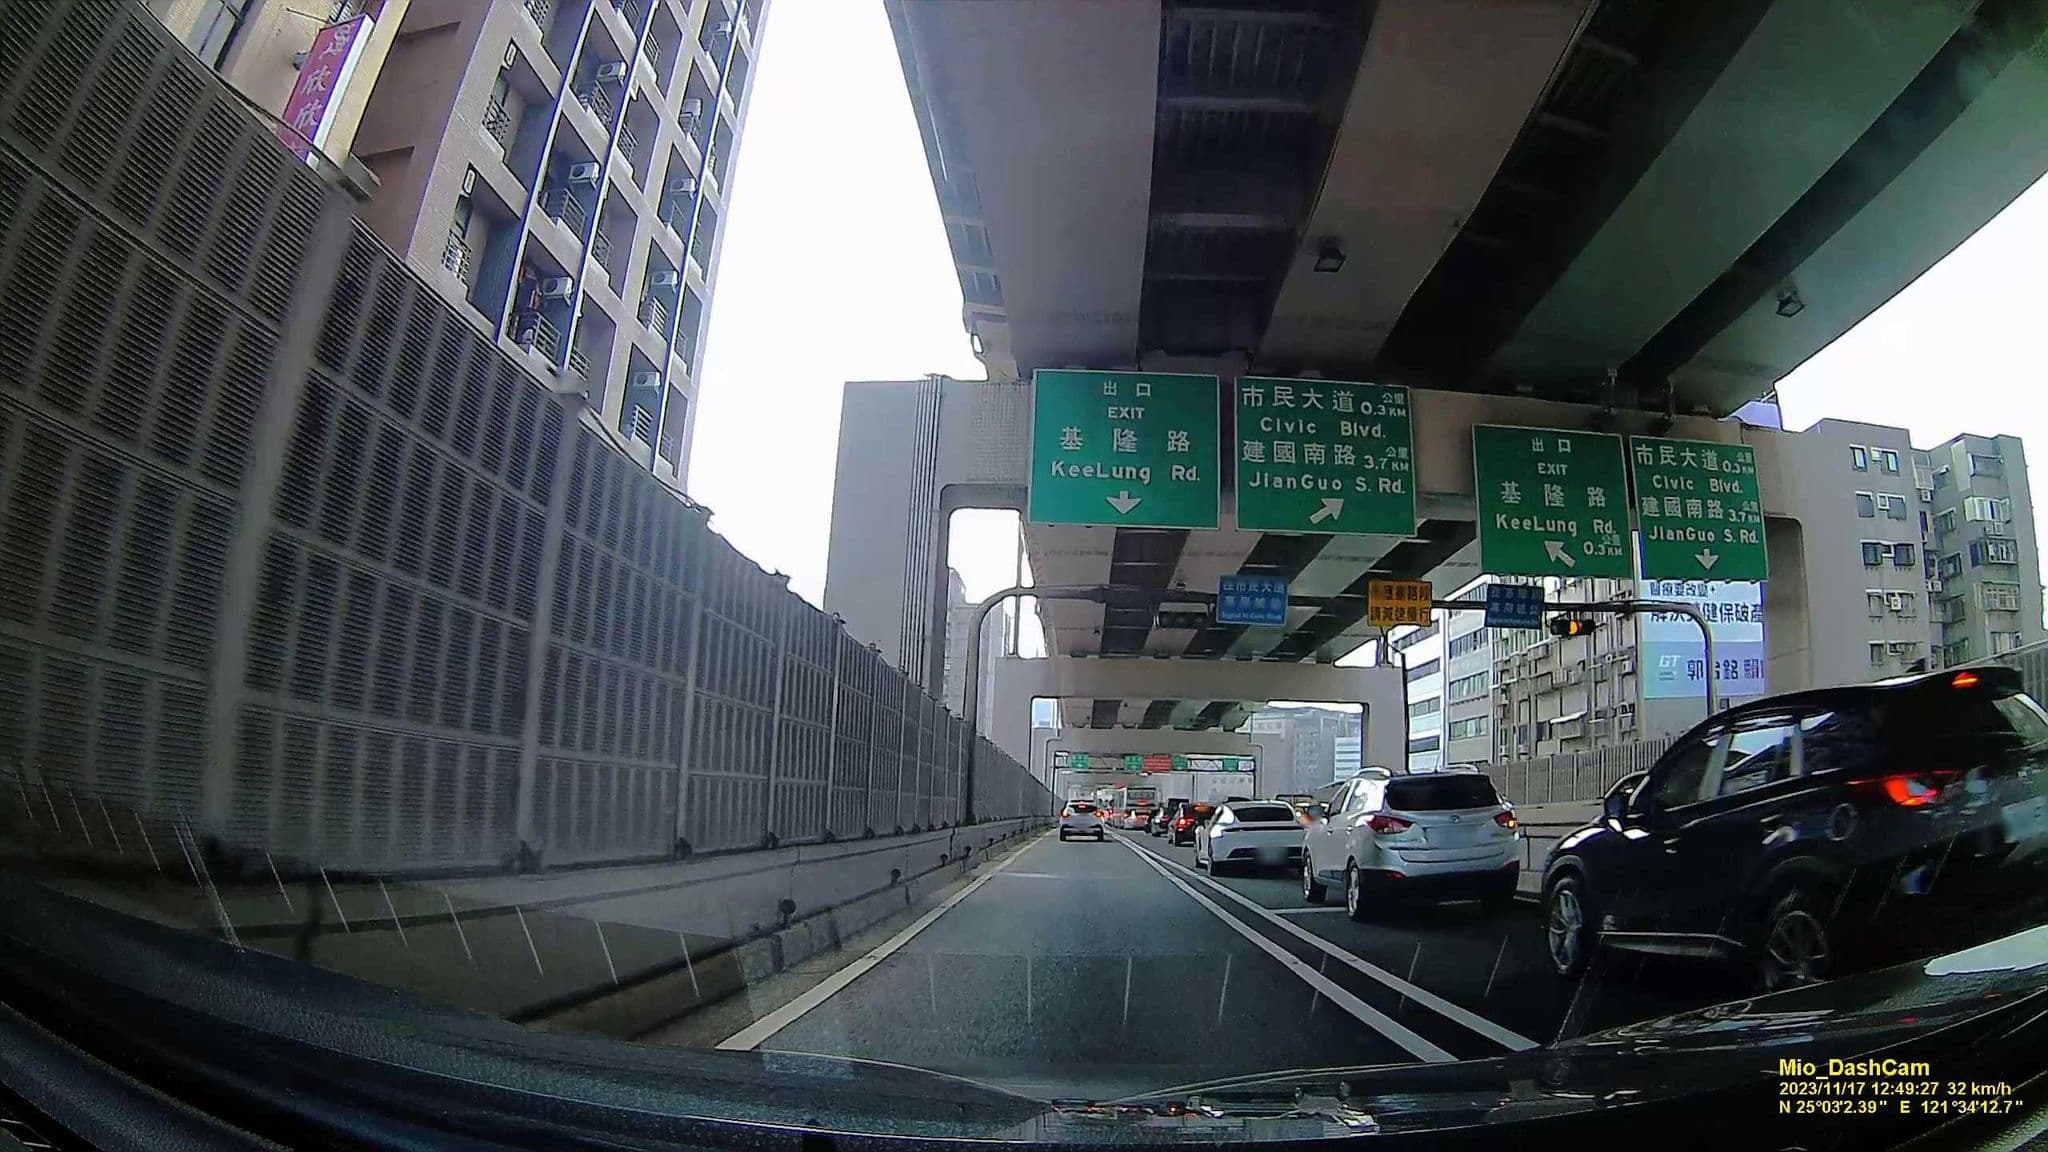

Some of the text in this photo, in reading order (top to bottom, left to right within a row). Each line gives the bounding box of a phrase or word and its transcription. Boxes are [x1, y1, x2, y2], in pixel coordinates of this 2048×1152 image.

[1103, 380, 1151, 397] 出口
[1382, 392, 1405, 405] 公里
[1241, 385, 1387, 416] 市民大道 0.3
[1107, 406, 1145, 419] EXIT
[1388, 406, 1407, 418] KM
[1260, 416, 1386, 439] Civic Blvd.
[1060, 426, 1191, 453] 基隆路
[1531, 437, 1572, 453] 出口
[1241, 440, 1389, 470] 建國南路 3.7
[1635, 443, 1741, 474] 市民大道 0.3
[1051, 460, 1200, 485] KeeLung Rd.
[1391, 460, 1409, 472] KM
[1537, 462, 1568, 476] EXIT
[1249, 471, 1406, 494] JianGuo S. Rd.
[1652, 474, 1743, 494] Civic Blvd.
[1500, 480, 1606, 508] 基隆路
[1640, 496, 1746, 523] 建國南路 3.7
[1495, 513, 1617, 538] KeeLung Rd.
[1648, 525, 1759, 544] JianGuo S. Rd.
[1583, 540, 1606, 556] 0.3
